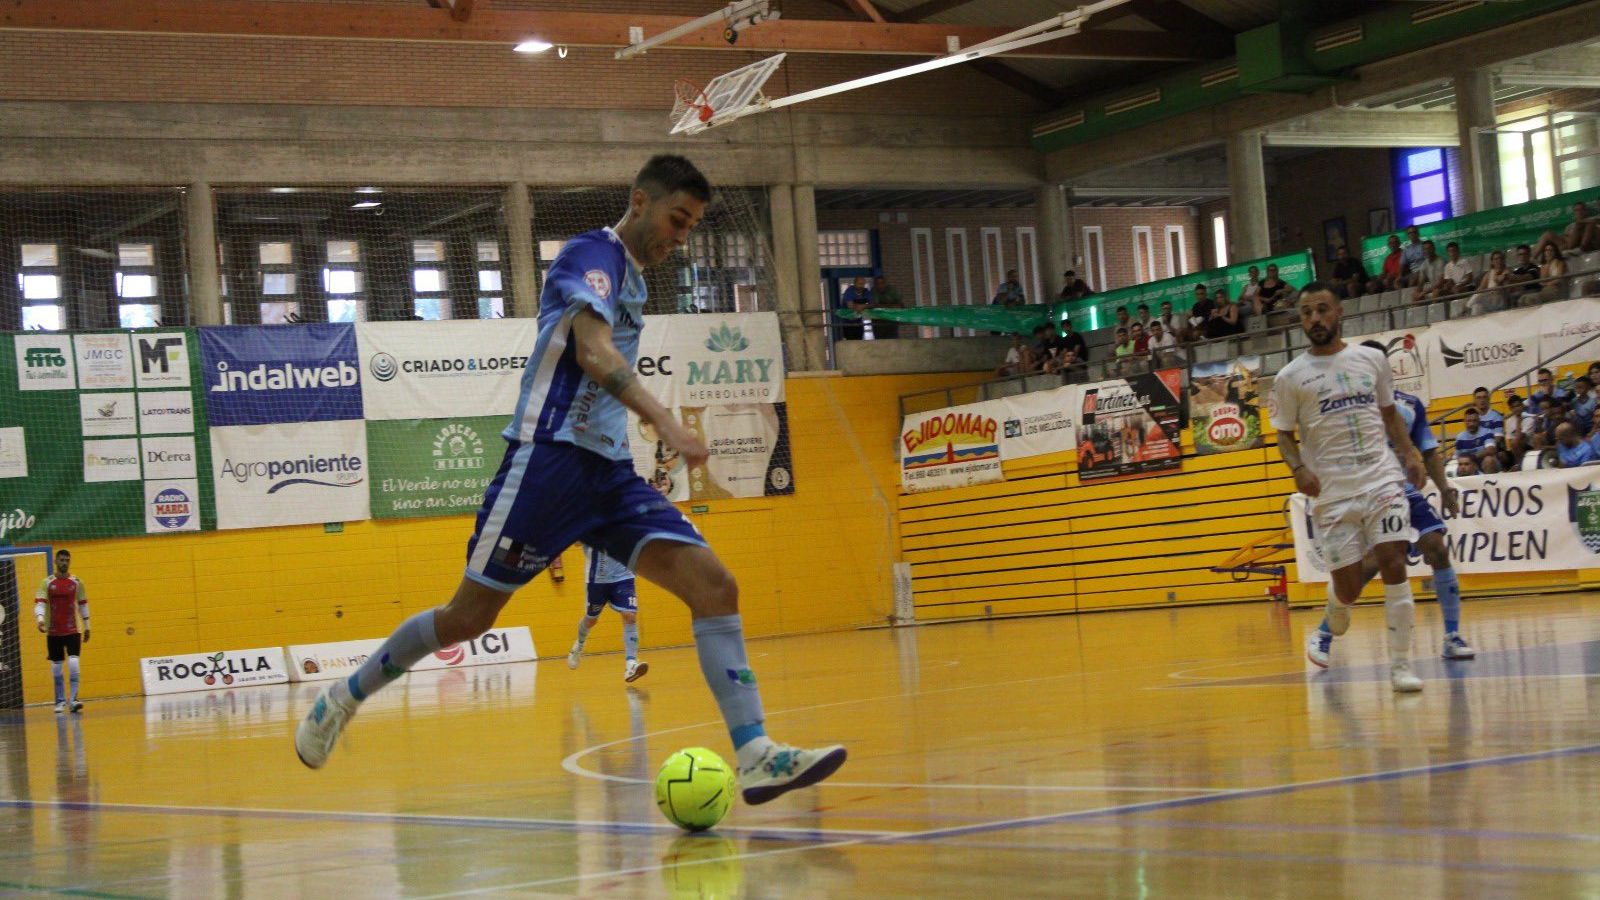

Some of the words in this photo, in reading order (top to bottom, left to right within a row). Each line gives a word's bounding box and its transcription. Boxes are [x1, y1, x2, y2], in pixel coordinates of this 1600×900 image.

[83, 349, 123, 360] JMGC
[211, 360, 358, 392] indalweb
[686, 358, 774, 386] MARY
[689, 388, 770, 401] HERBOLARIO
[903, 412, 998, 454] EJIDOMAR
[220, 453, 362, 483] Agroponiente
[398, 476, 440, 492] Verde
[156, 503, 189, 515] MARCA
[1381, 514, 1404, 534] 10
